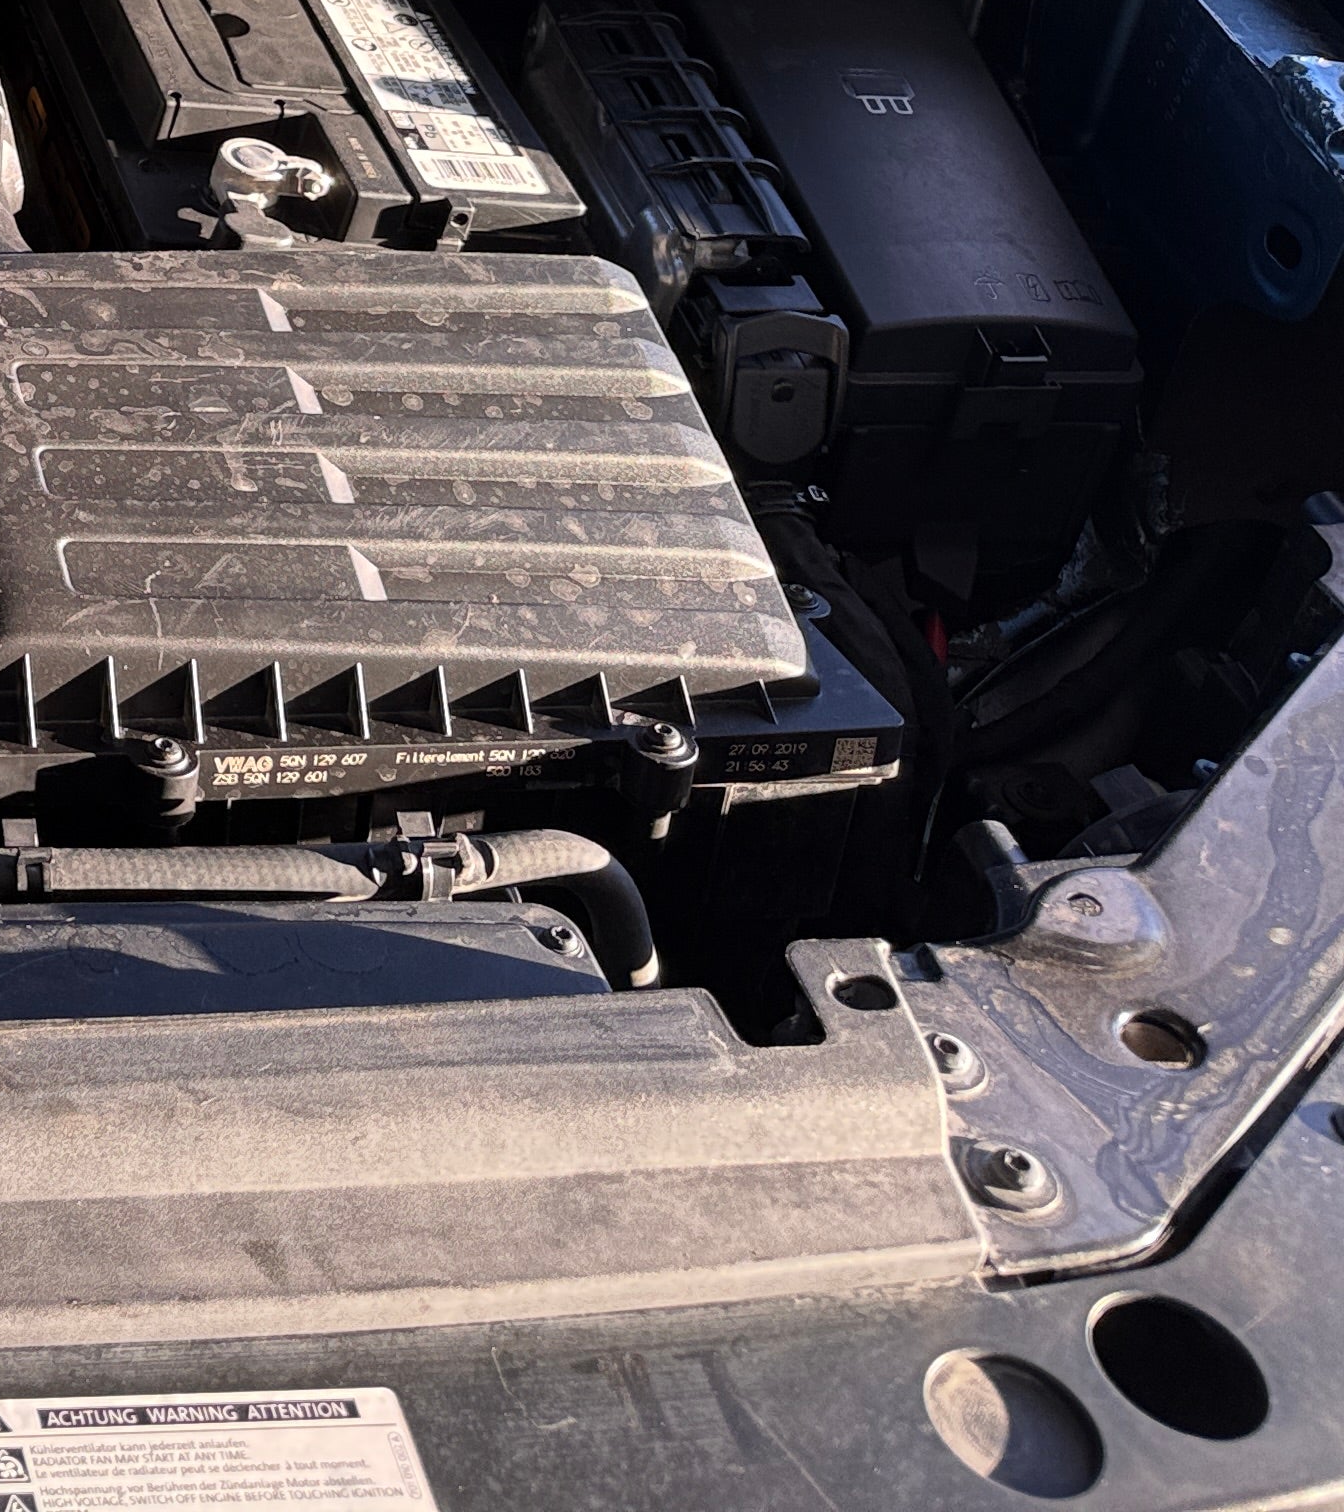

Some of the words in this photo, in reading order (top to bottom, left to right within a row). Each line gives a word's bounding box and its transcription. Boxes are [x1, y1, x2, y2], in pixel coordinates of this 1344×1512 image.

[214, 756, 273, 773] VWAG
[279, 755, 307, 768] 5QN
[313, 754, 338, 766] 129
[340, 753, 368, 766] 607
[395, 750, 485, 765] Filterelement
[212, 773, 239, 786] ZSB
[276, 772, 300, 784] 129
[304, 770, 328, 783] 601
[519, 765, 542, 776] 183
[47, 1408, 138, 1426] ACHTUNG
[146, 1405, 238, 1423] WARNING
[247, 1402, 348, 1420] ATTENTION
[120, 1441, 146, 1452] kann
[148, 1439, 196, 1454] jederzeit
[32, 1454, 88, 1467] RADIATOR
[90, 1454, 113, 1465] FAN
[115, 1453, 140, 1464] MAY
[142, 1452, 175, 1463] START
[178, 1451, 191, 1462] AT
[194, 1450, 216, 1462] ANY
[35, 1468, 48, 1479] Le
[50, 1466, 109, 1478] ventilateur
[112, 1465, 125, 1476] de
[128, 1464, 178, 1476] radiateur
[181, 1463, 205, 1477] peut
[207, 1464, 220, 1474] se
[295, 1460, 318, 1471] tout
[127, 1485, 144, 1495] vor
[146, 1482, 202, 1494] Berühren
[204, 1480, 217, 1492] der
[220, 1478, 285, 1492] Zündanlage
[286, 1478, 320, 1489] Motor
[43, 1497, 73, 1509] HIGH
[130, 1494, 175, 1507] SWITCH
[177, 1493, 197, 1504] OFF
[199, 1491, 243, 1504] ENGINE
[245, 1490, 286, 1503] BEFORE
[288, 1488, 351, 1501] TOUCHING
[352, 1486, 404, 1499] IGNITION
